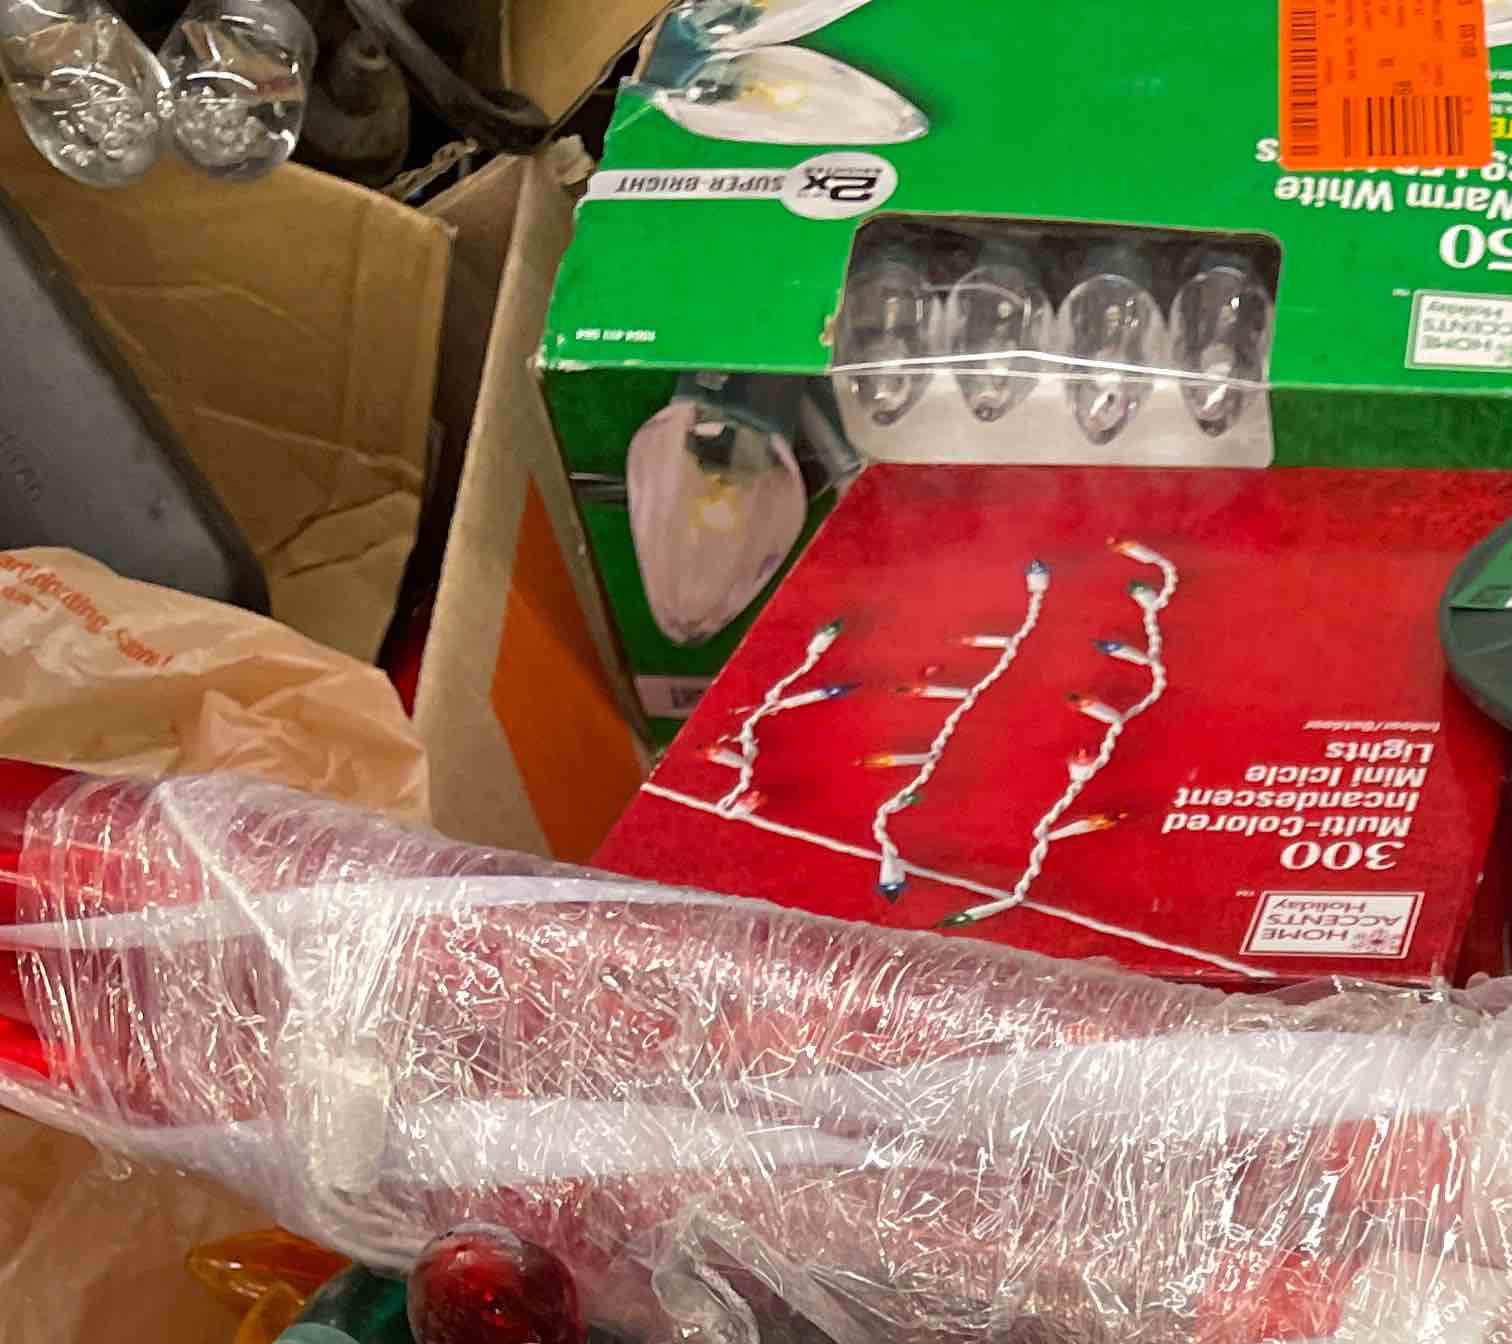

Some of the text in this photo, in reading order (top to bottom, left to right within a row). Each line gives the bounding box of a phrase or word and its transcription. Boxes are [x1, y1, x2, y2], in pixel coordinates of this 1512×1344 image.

[615, 176, 700, 193] BRIGHT
[709, 175, 786, 193] SUPER
[1274, 176, 1394, 213] White
[1422, 336, 1492, 352] HOME
[1325, 739, 1434, 764] Lights
[1245, 765, 1428, 788] Mini Icicle
[1174, 787, 1420, 812] Incandescent
[1162, 812, 1412, 837] Multi-Colored
[1280, 841, 1405, 870] 300
[1273, 899, 1366, 913] Holiday
[1266, 914, 1402, 926] ACCENTS
[1262, 929, 1348, 940] HOME
